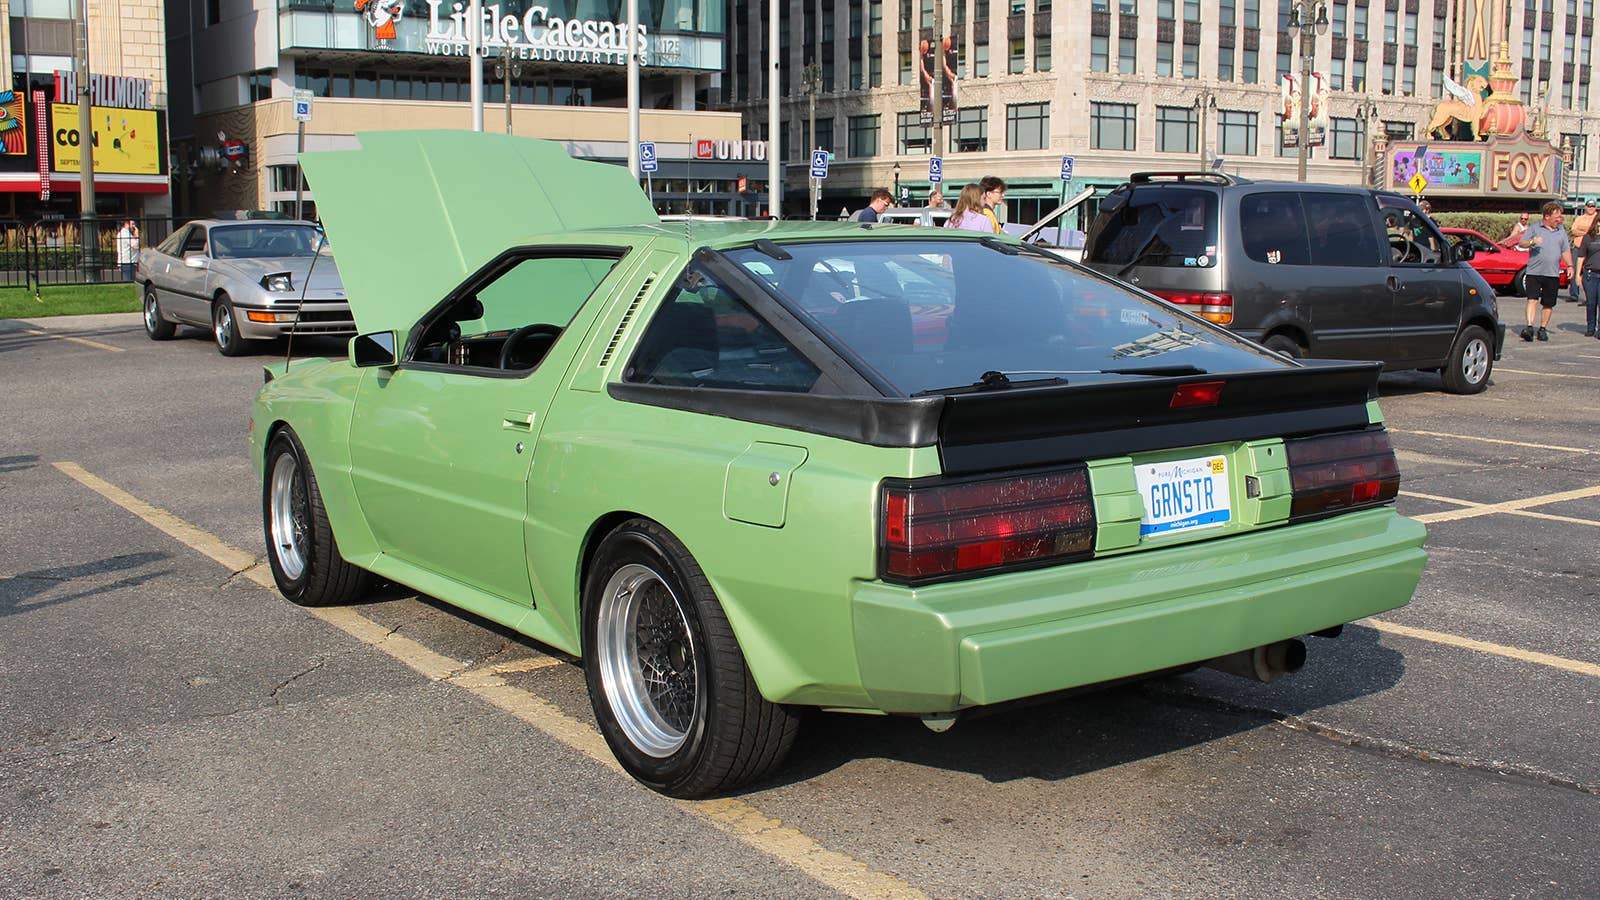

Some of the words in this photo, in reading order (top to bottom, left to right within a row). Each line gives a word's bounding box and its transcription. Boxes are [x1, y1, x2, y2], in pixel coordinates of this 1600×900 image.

[425, 0, 519, 44] Little
[523, 6, 648, 51] Caesars
[506, 46, 648, 66] EADQUARTES
[53, 70, 78, 104] TH
[90, 73, 153, 110] FILLMORE
[56, 128, 99, 148] CON
[717, 140, 769, 160] UNIO
[1490, 151, 1551, 192] FOX
[1212, 462, 1225, 471] DEC
[1151, 476, 1214, 519] GRNSTR
